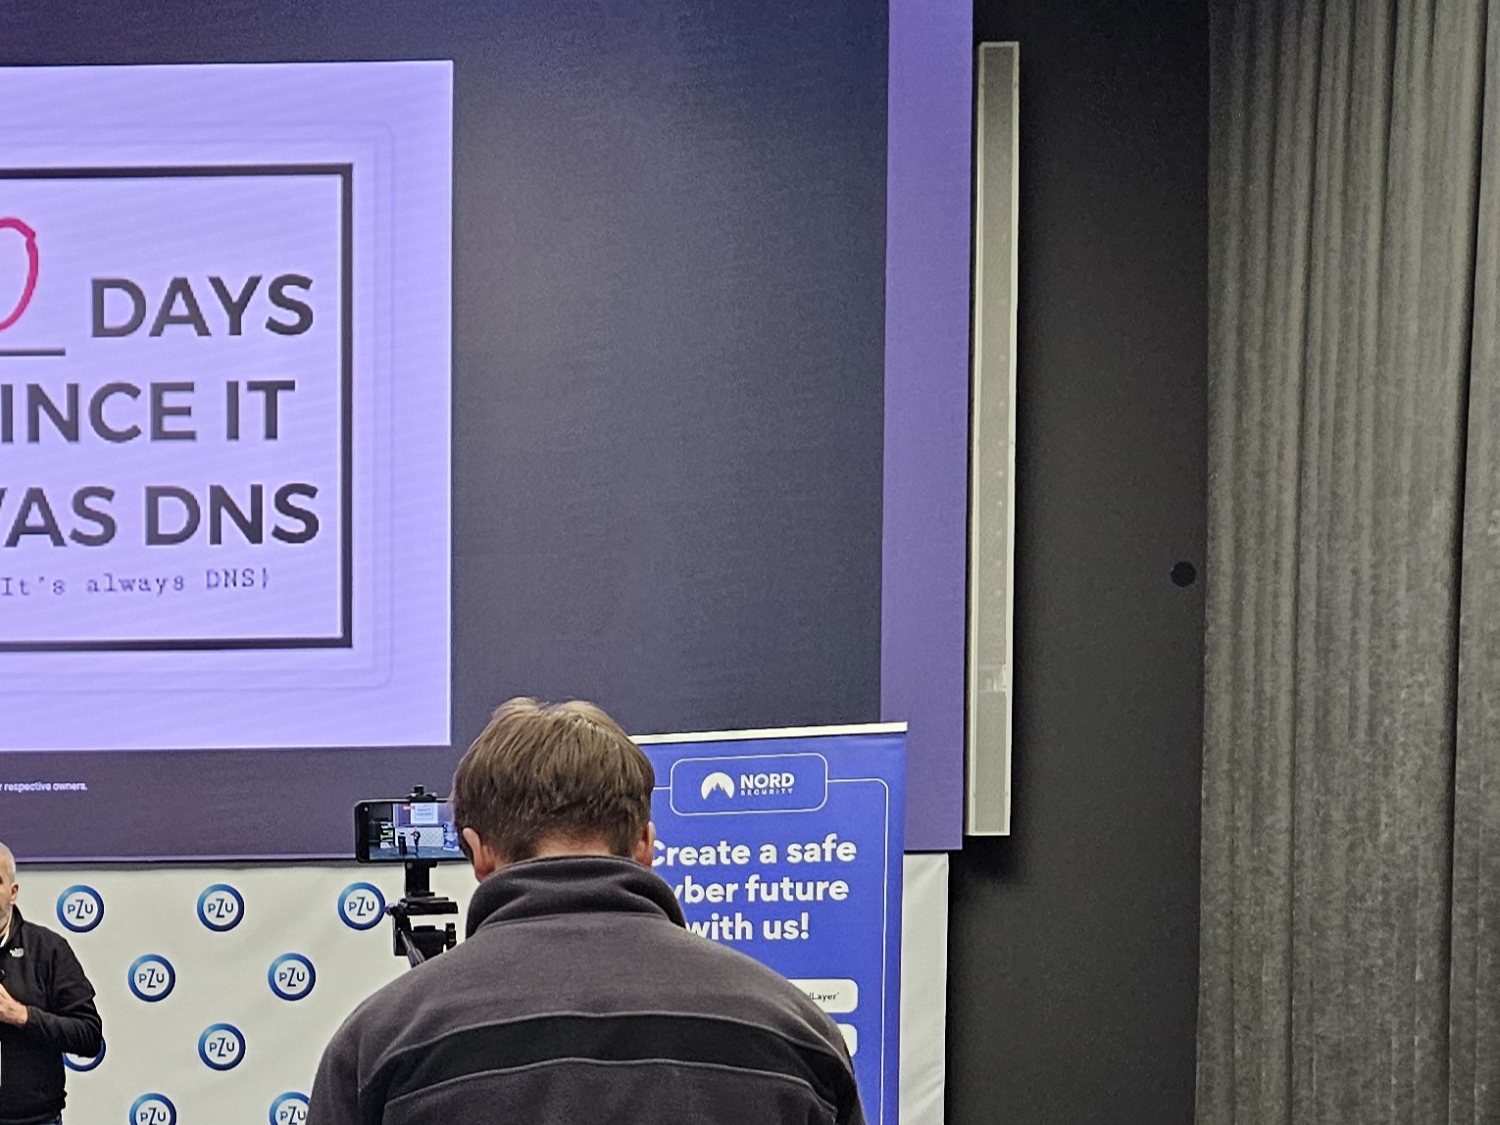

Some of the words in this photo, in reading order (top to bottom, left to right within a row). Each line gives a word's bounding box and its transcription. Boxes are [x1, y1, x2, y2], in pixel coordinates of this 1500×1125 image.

[92, 274, 313, 337] DAYS
[227, 380, 295, 440] IT
[146, 483, 319, 545] DNS
[88, 573, 184, 595] always
[4, 782, 51, 792] respective
[741, 773, 794, 789] NORD
[741, 789, 793, 797] SECURITY
[652, 840, 750, 867] Create
[760, 844, 777, 864] a
[787, 833, 856, 863] safe
[674, 875, 739, 904] ber
[745, 874, 849, 902] future
[68, 900, 93, 919] PZU
[208, 899, 233, 918] PZU
[349, 897, 374, 916] PZU
[686, 912, 753, 940] with
[763, 912, 809, 940] us!
[139, 969, 164, 988] PZU
[279, 968, 305, 987] PZU
[210, 1038, 234, 1057] PZU
